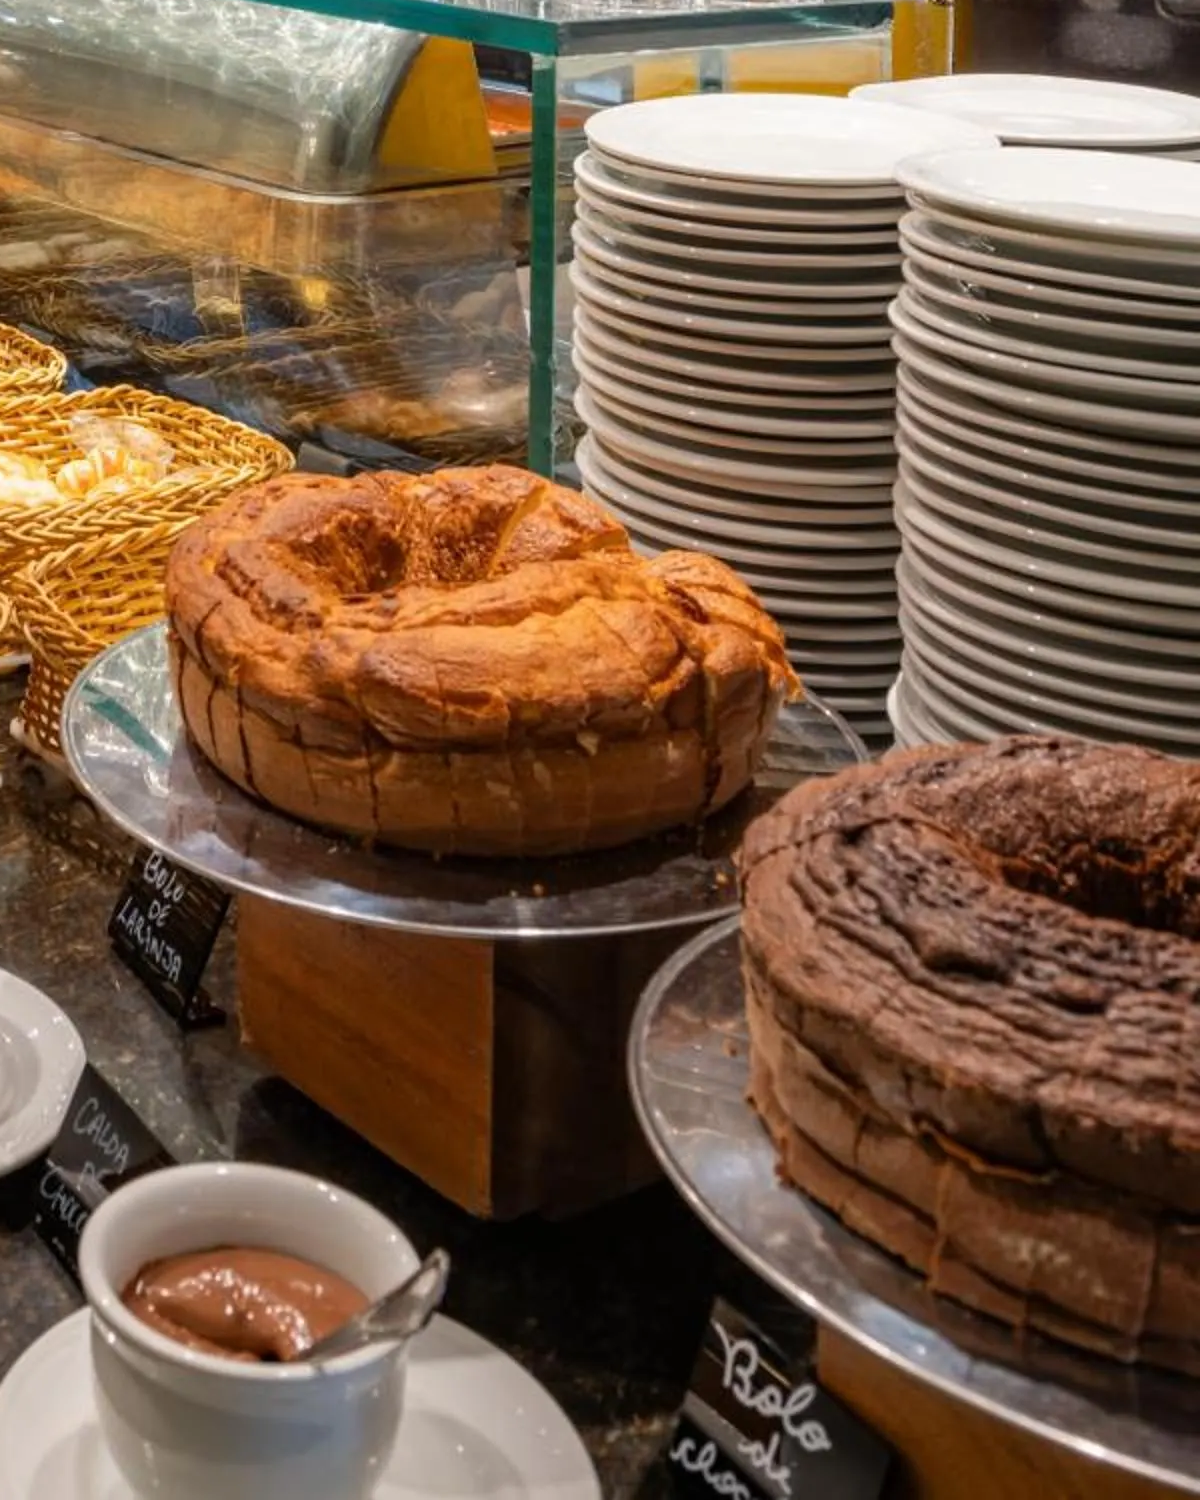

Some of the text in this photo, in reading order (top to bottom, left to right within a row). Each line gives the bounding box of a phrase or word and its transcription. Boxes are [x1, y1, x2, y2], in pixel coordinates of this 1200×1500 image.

[72, 1097, 130, 1176] CALDA
[710, 1316, 832, 1452] Bolo
[737, 1431, 792, 1495] de
